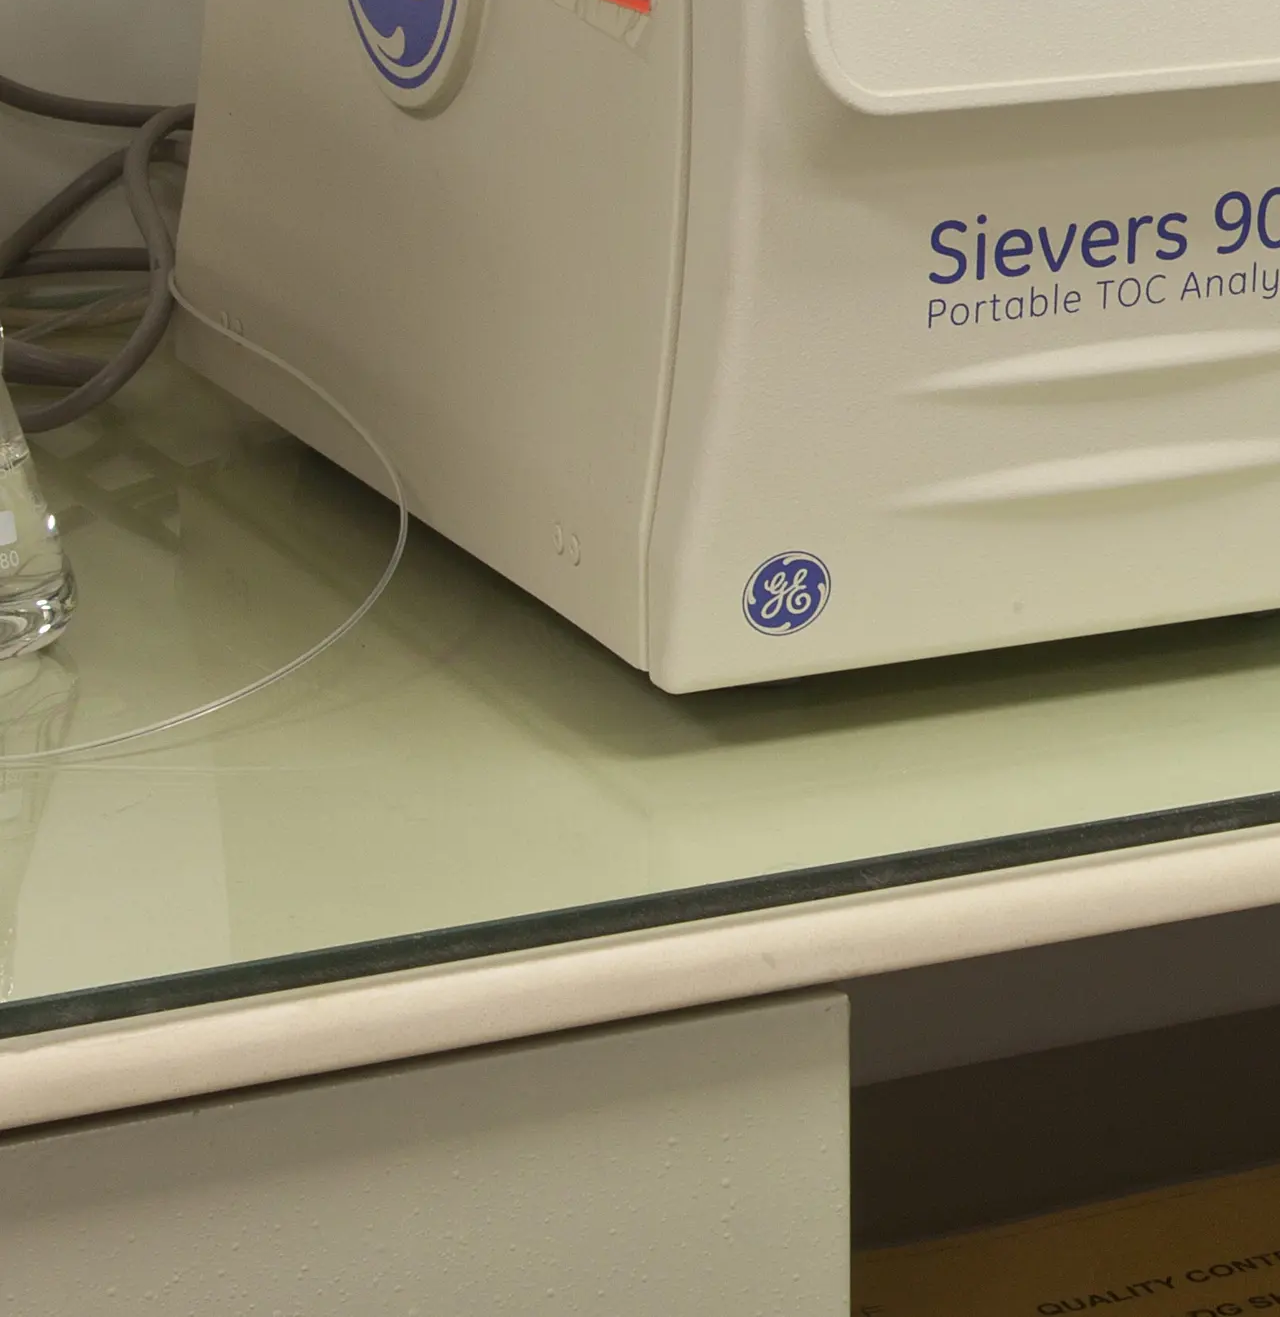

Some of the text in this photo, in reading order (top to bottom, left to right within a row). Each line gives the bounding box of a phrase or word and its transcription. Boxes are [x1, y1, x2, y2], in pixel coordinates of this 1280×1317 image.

[928, 212, 1189, 285] Sievers
[927, 283, 1083, 330] Portable
[1096, 274, 1168, 310] TOC
[1036, 1275, 1175, 1317] QUALITY
